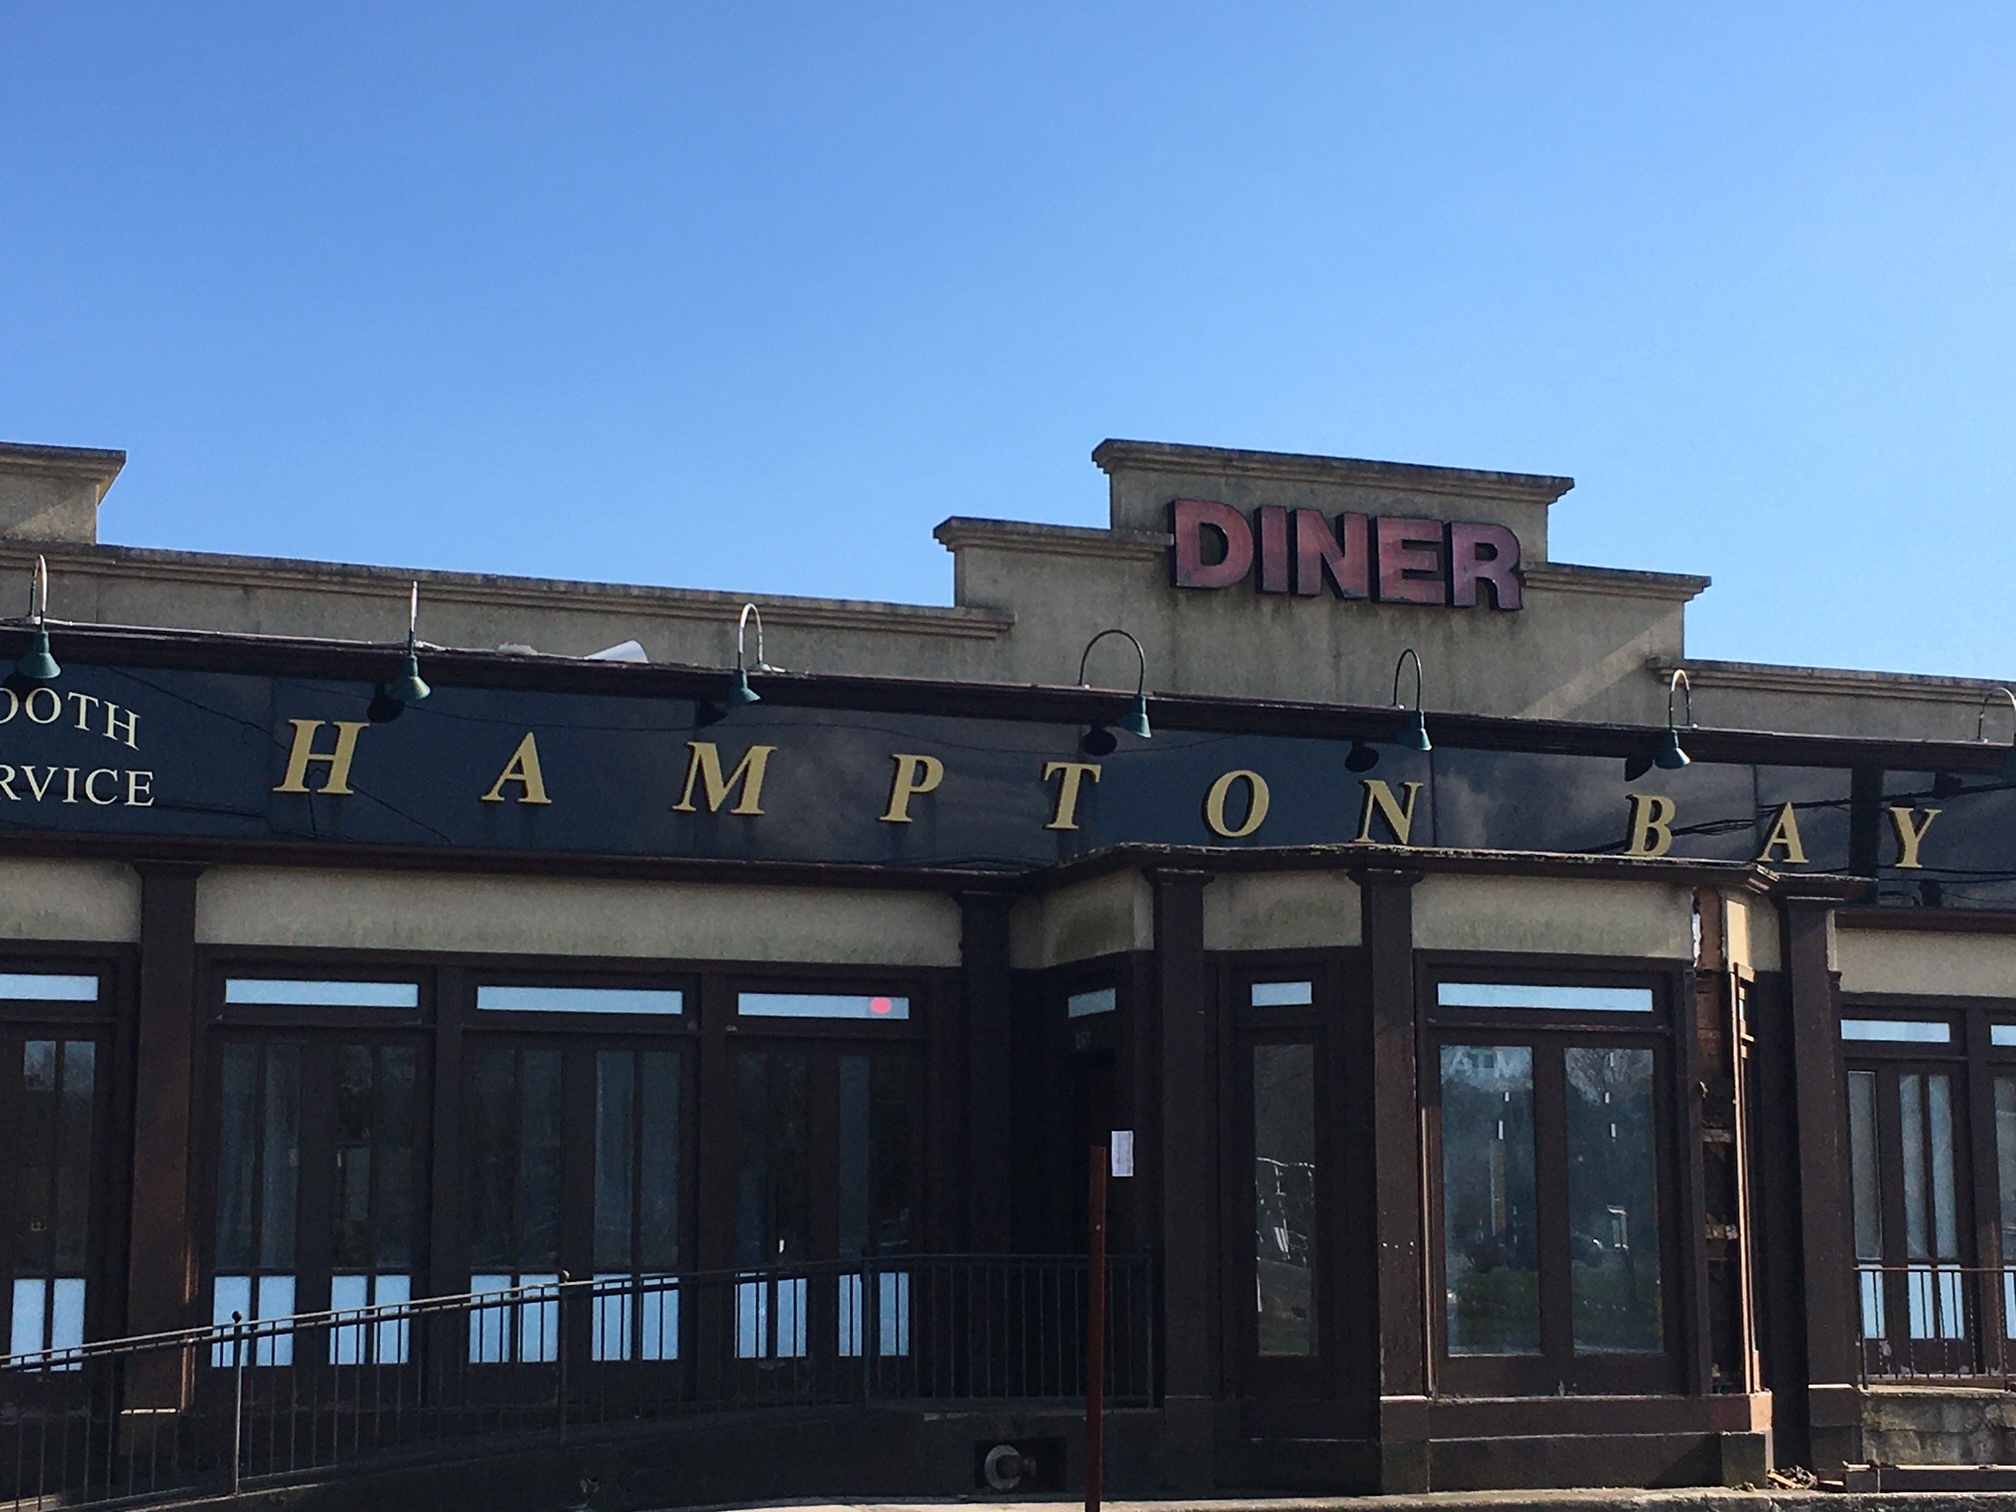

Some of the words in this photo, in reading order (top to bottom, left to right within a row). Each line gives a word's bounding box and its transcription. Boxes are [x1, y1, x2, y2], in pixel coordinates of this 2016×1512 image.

[1170, 498, 1524, 611] DINER
[0, 764, 155, 807] RVICE
[272, 717, 1424, 846] HAMPTON
[1623, 794, 1943, 869] BAY
